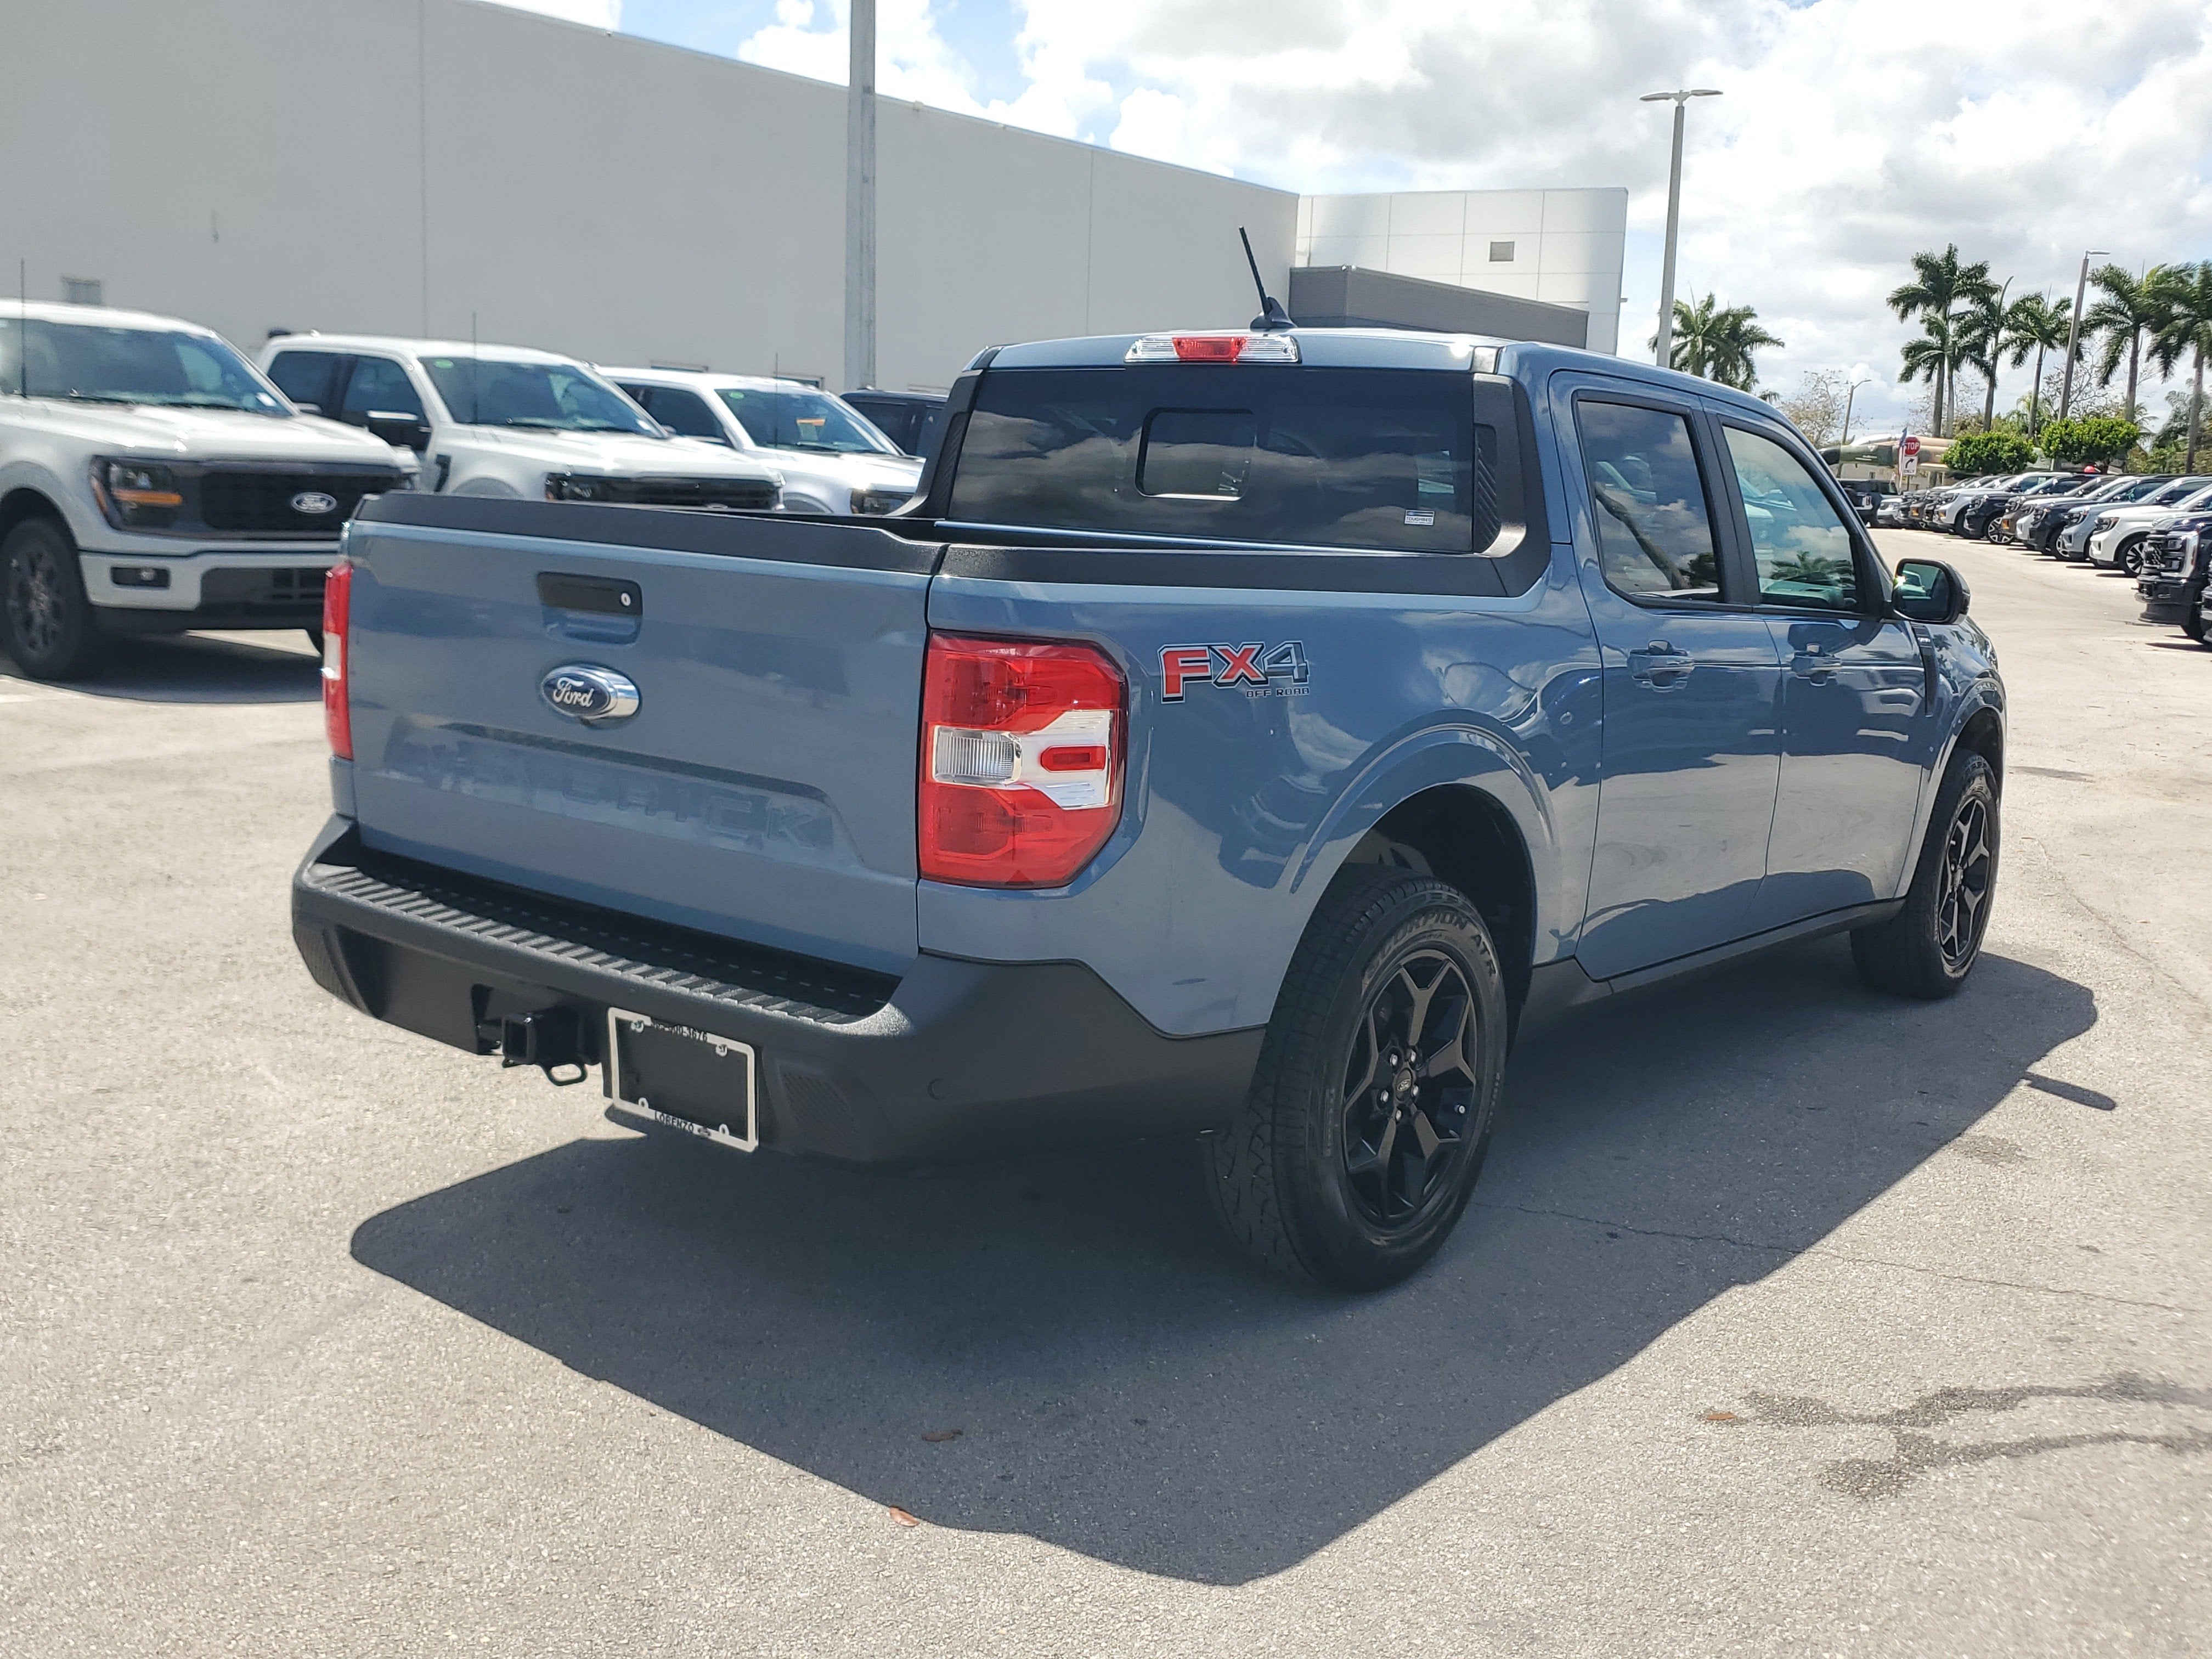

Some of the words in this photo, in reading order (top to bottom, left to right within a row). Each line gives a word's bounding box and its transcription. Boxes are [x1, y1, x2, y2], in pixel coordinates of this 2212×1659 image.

[1158, 640, 1310, 704] FX4
[552, 676, 595, 708] Ford
[1246, 689, 1271, 698] OFF
[1277, 688, 1310, 697] ROAD
